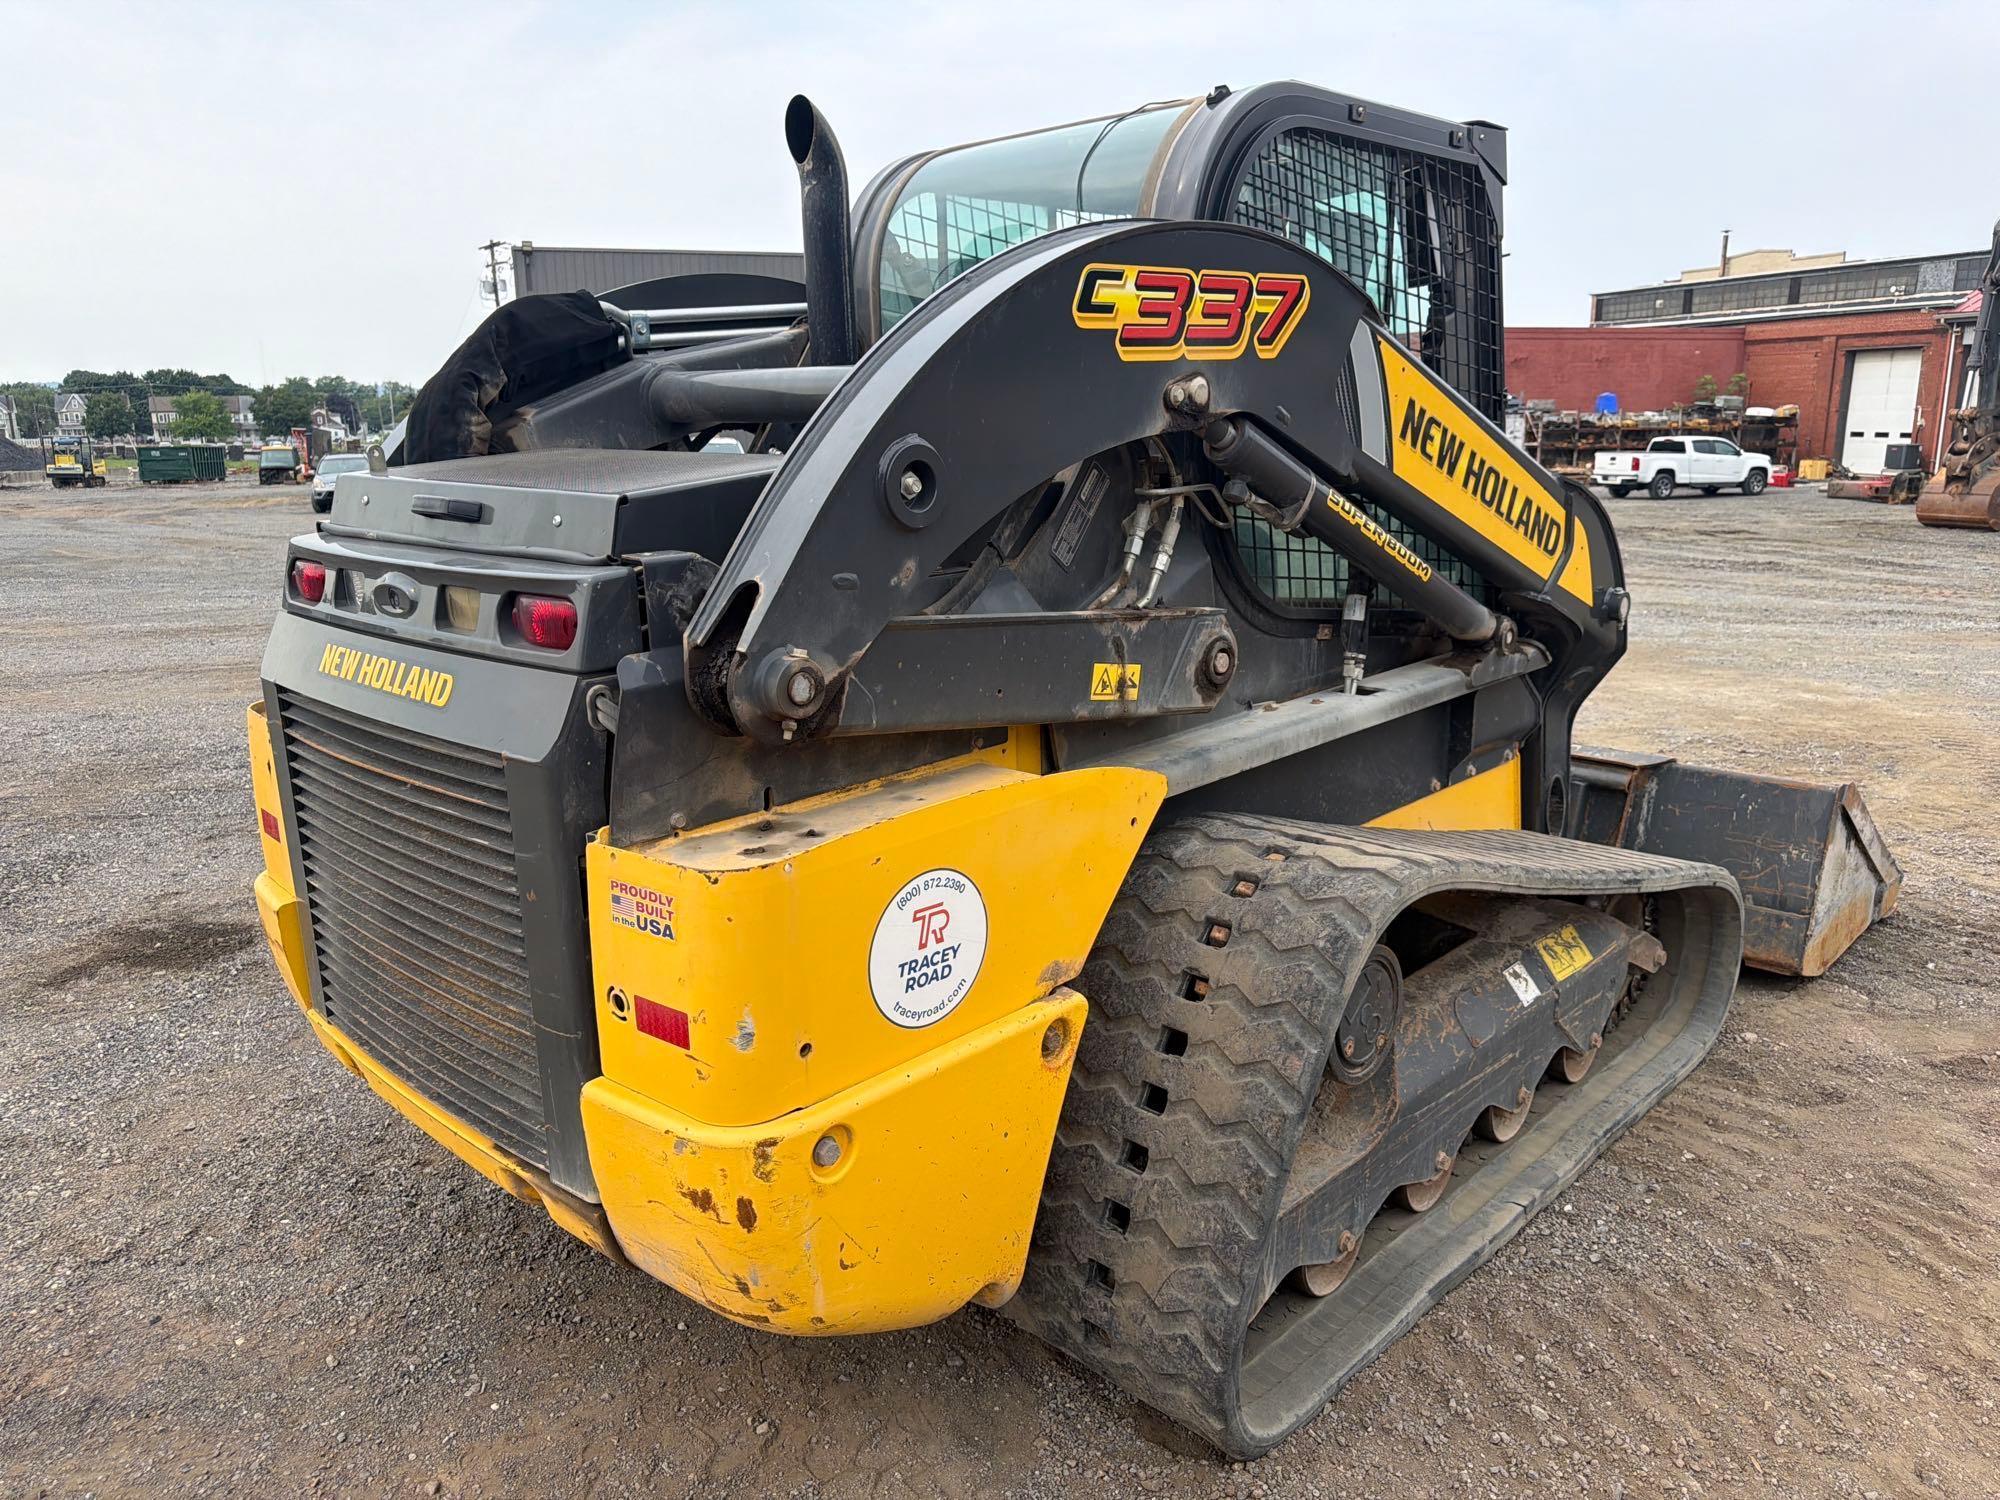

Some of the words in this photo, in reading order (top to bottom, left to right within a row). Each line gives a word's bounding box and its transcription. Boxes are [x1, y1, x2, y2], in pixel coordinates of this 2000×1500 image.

[1399, 398, 1465, 479] NEW
[1462, 450, 1562, 558] HOLLAND
[318, 643, 362, 681] NEW
[357, 653, 454, 707] HOLLAND
[610, 880, 674, 907] PROUDLY
[896, 884, 921, 911] (800)
[923, 877, 966, 894] 872.2390
[612, 914, 621, 923] in
[622, 917, 635, 928] the
[636, 915, 674, 940] USA
[635, 901, 674, 921] BUILT
[898, 943, 961, 978] TRACEY
[904, 964, 952, 994] ROAD
[893, 978, 967, 1021] traceyroad.com
